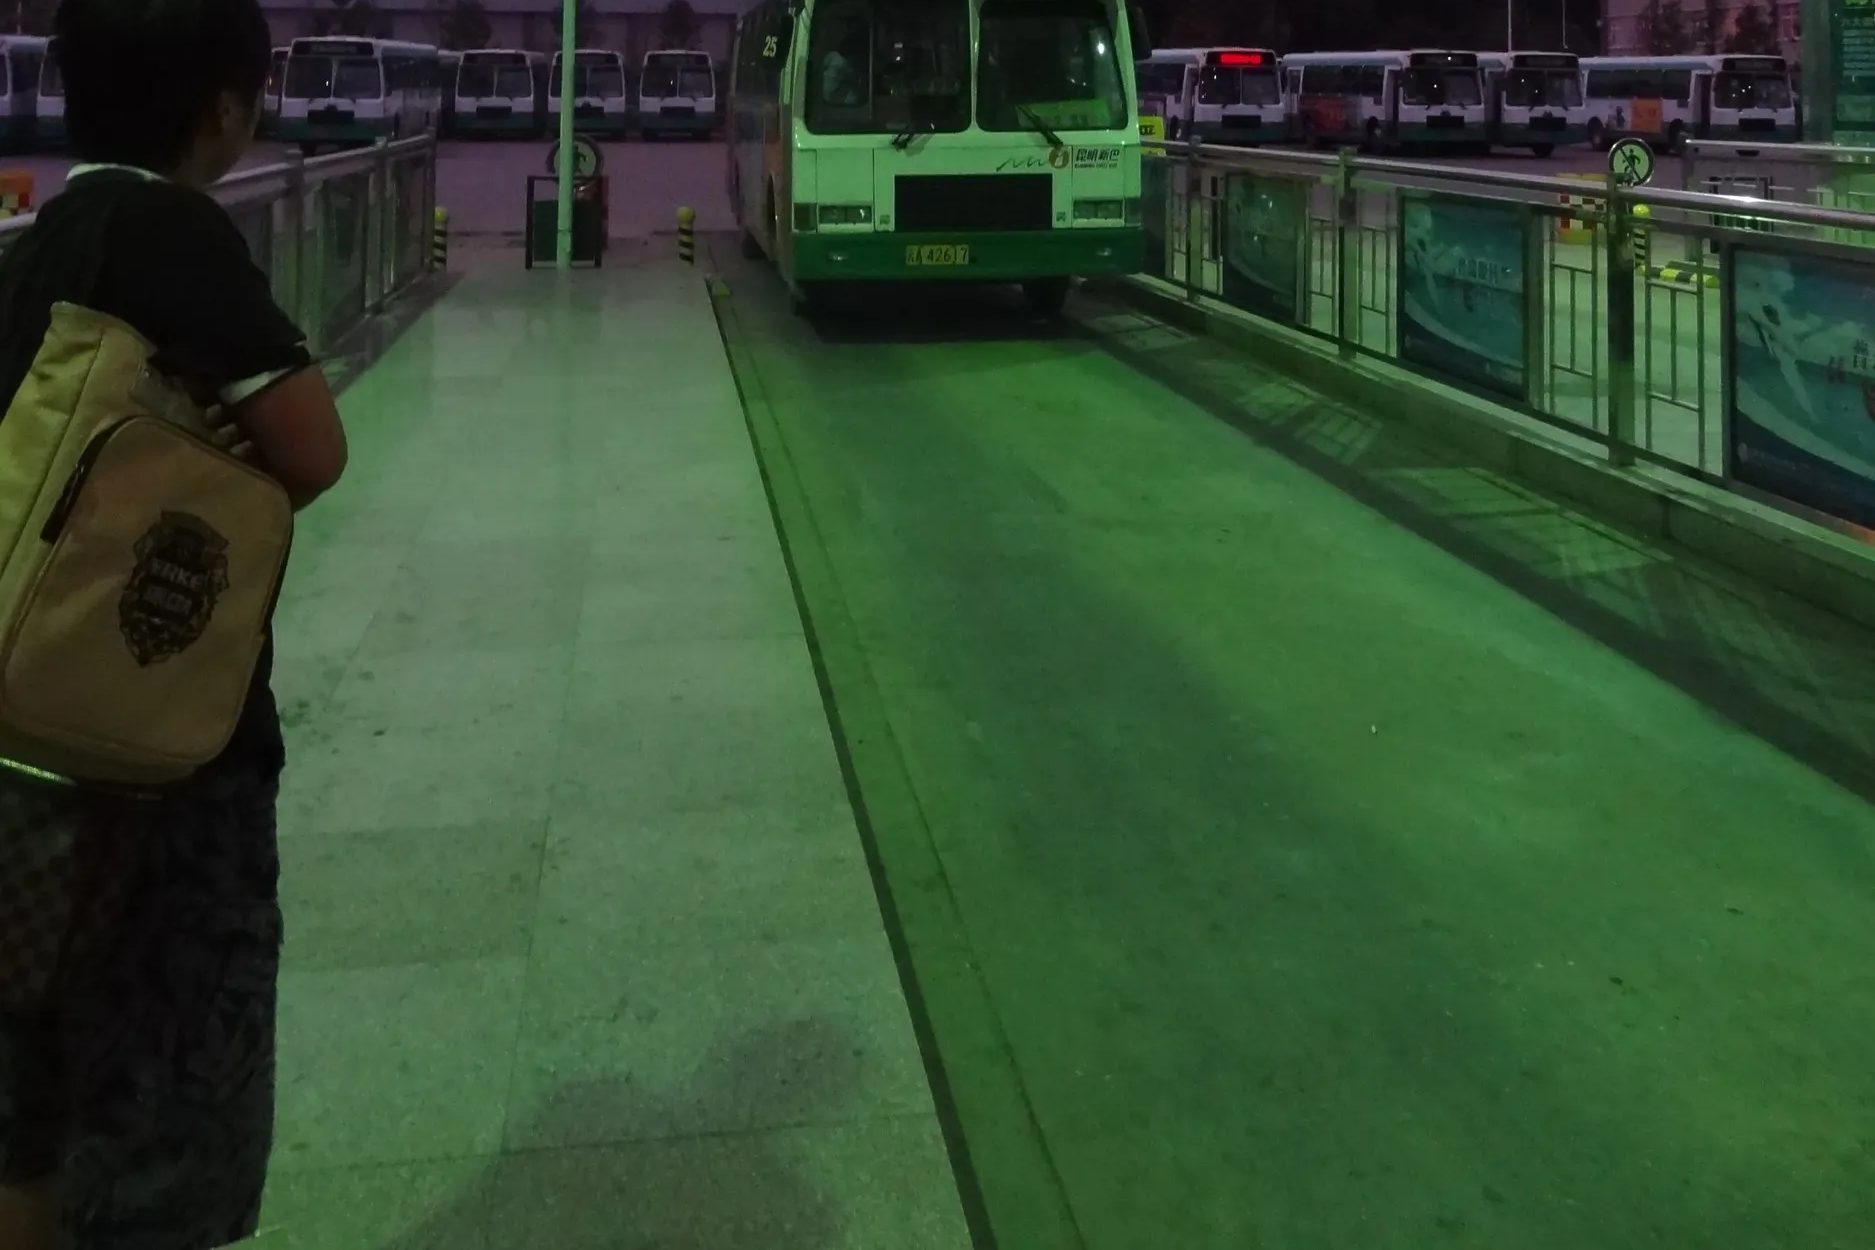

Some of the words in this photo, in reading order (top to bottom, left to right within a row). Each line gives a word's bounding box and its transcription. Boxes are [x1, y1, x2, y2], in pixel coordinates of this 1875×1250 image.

[762, 35, 778, 58] 25
[1076, 147, 1120, 162] 昆明新巴
